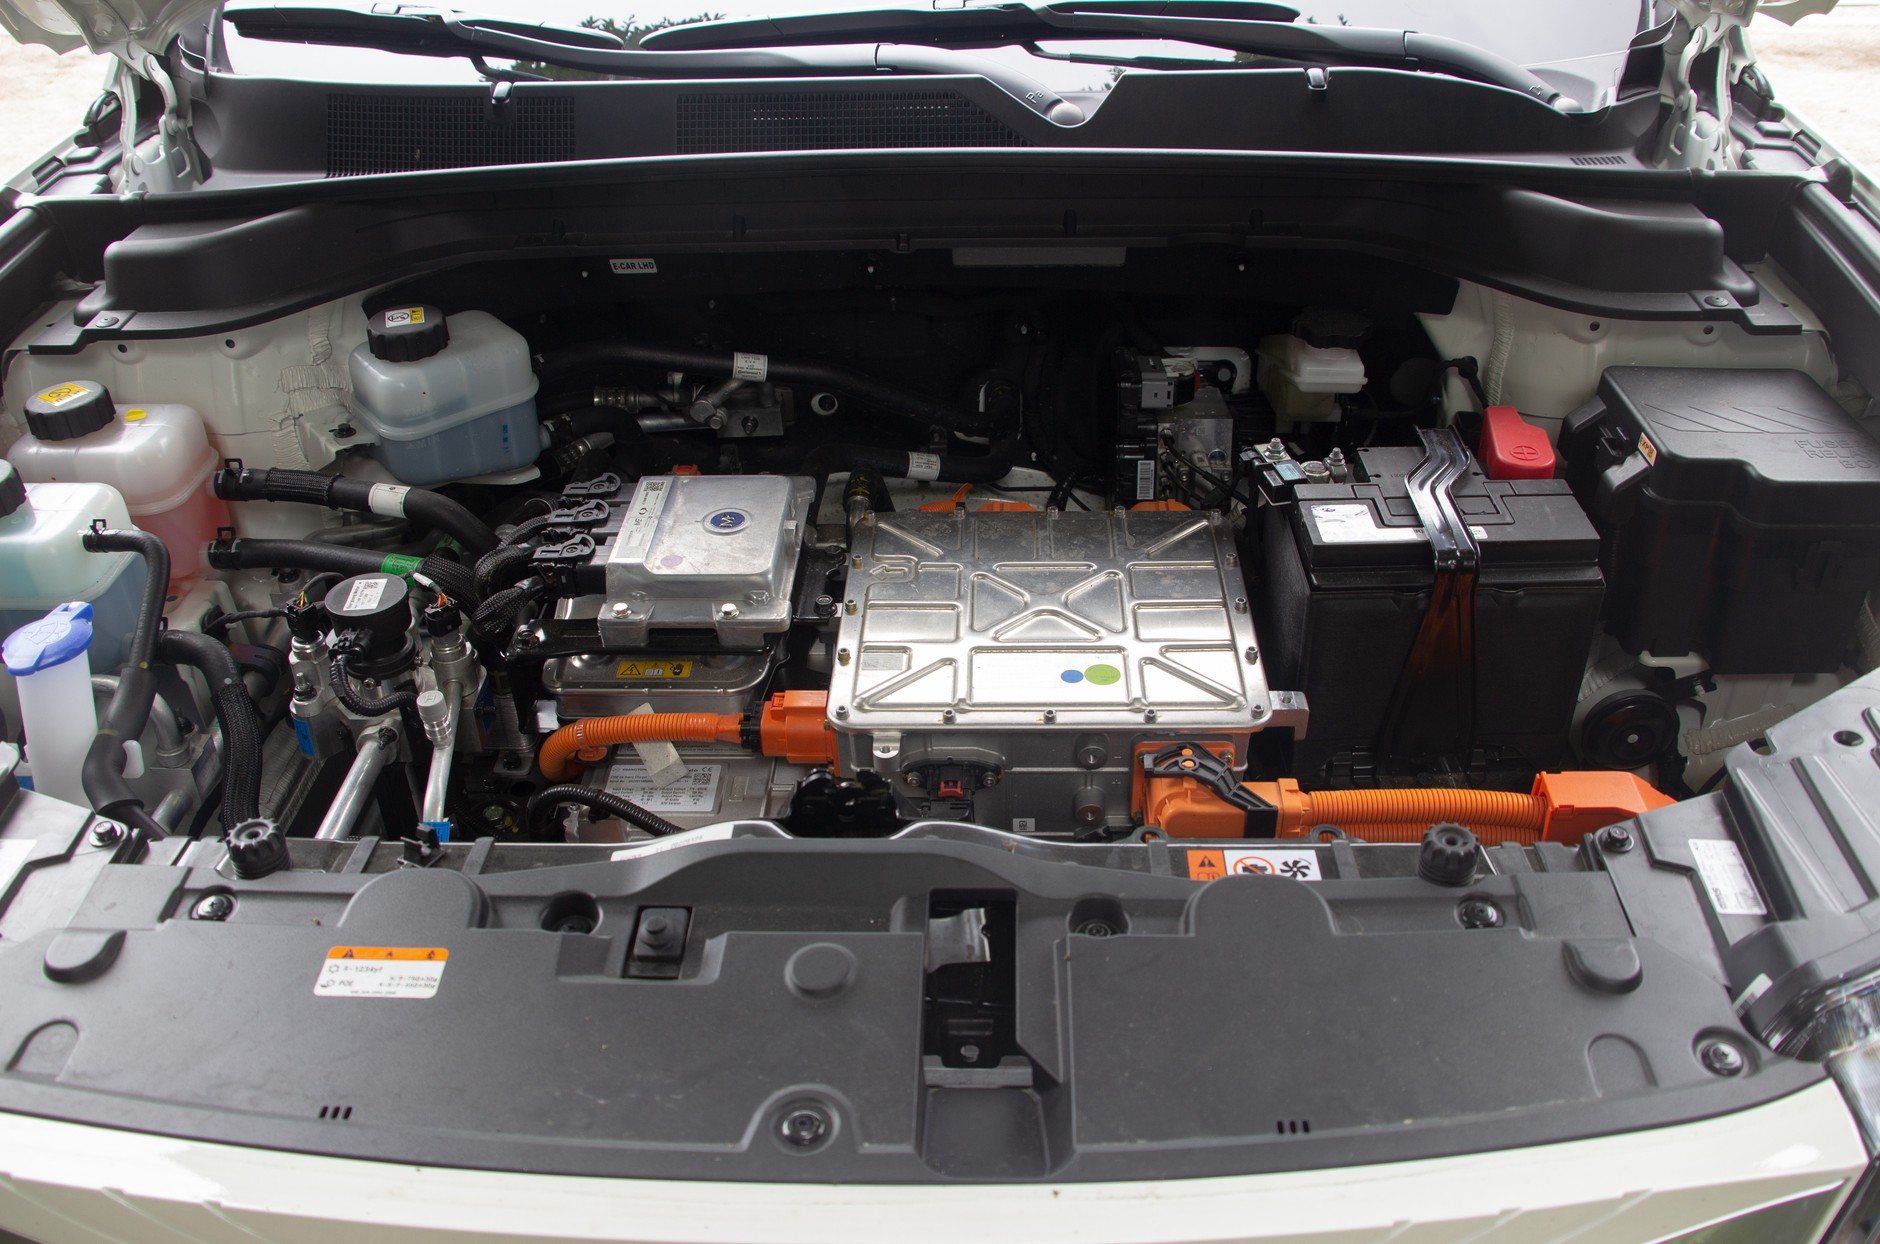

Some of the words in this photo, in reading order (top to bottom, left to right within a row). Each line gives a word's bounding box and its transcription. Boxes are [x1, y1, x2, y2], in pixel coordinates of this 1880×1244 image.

[612, 262, 637, 270] E-CAR
[638, 261, 655, 270] LHD
[1794, 439, 1854, 449] FUSE
